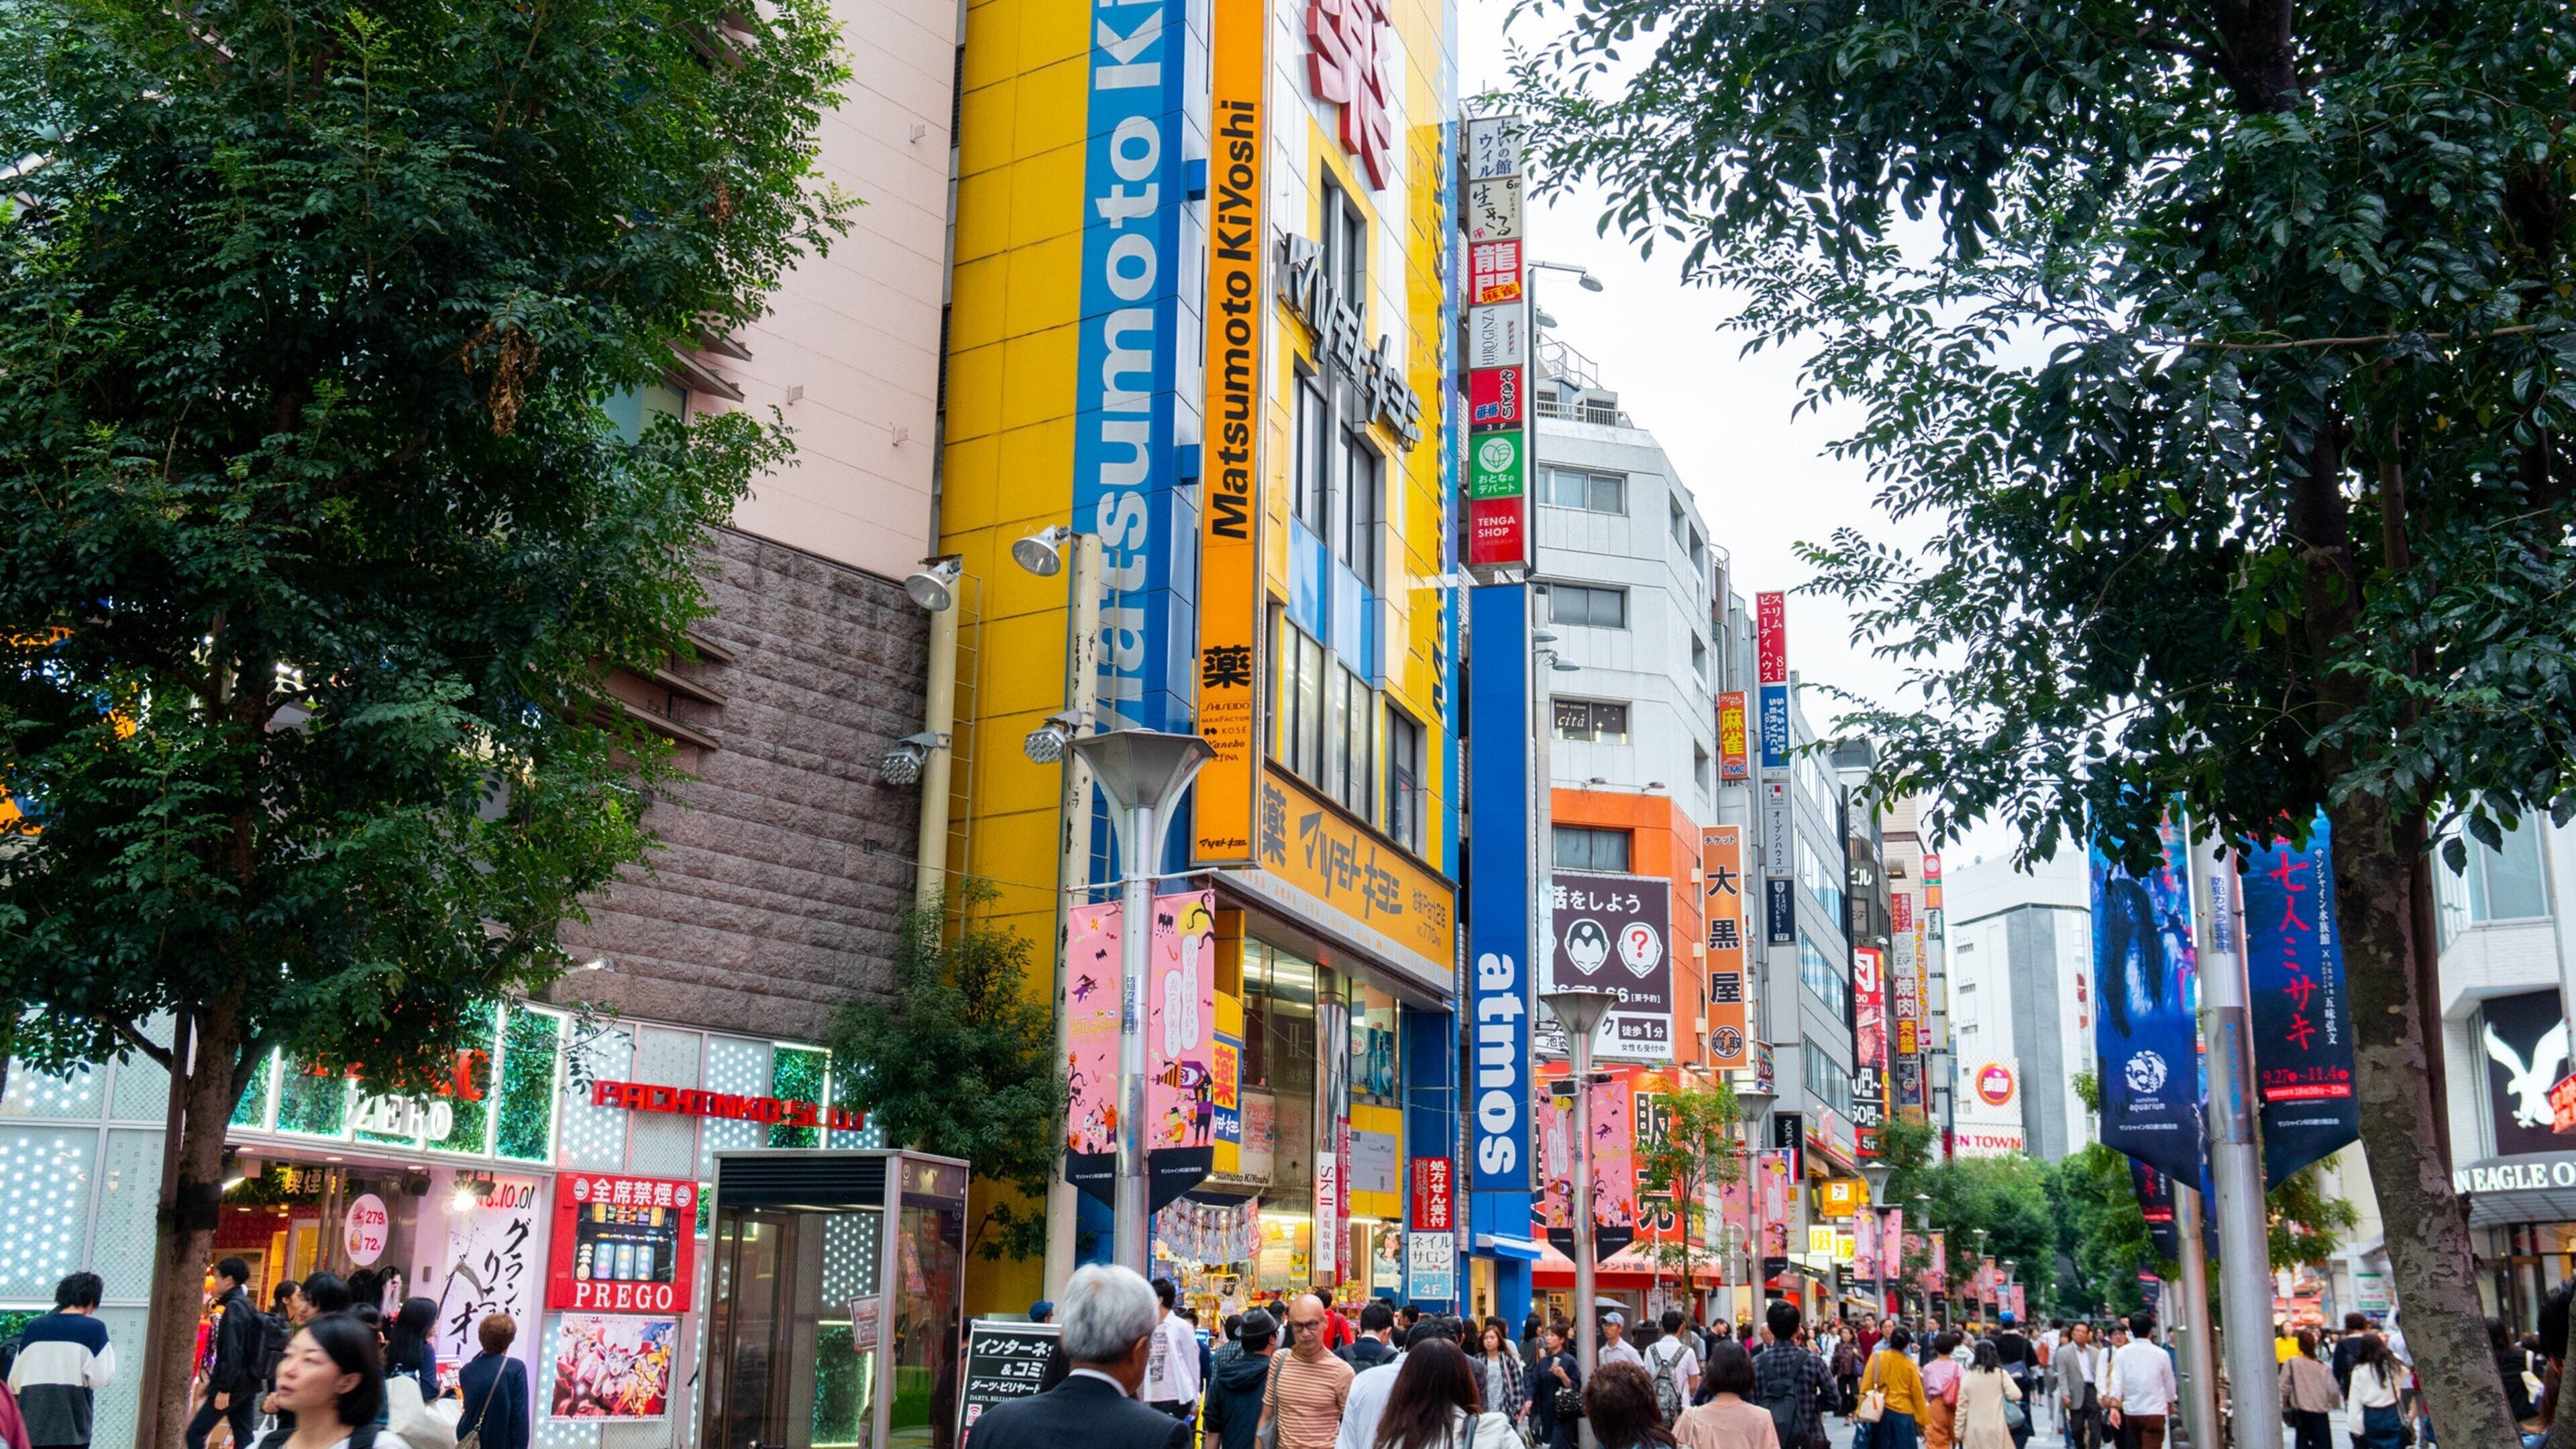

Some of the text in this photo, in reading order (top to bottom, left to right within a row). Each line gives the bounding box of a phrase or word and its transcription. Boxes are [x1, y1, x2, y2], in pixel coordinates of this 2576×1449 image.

[1482, 282, 1519, 303] 麻雀
[1212, 101, 1255, 539] Matsumoto KiYoshi
[1501, 370, 1515, 419] やきとり
[1479, 474, 1515, 484] おとなの
[1479, 484, 1515, 494] デパート
[1478, 515, 1516, 526] TENGA
[1478, 527, 1509, 537] SHOP
[1772, 594, 1783, 629] スリム
[1202, 645, 1252, 689] 薬
[1201, 702, 1250, 712] SHISEIDO
[1722, 708, 1745, 755] 麻雀
[1769, 698, 1777, 755] SERVICE
[1777, 698, 1786, 755] SYSTEM
[1705, 837, 1736, 845] チケット
[1773, 810, 1782, 865] オープンハウス
[1707, 866, 1742, 1004] 大黒屋
[2268, 851, 2318, 1051] 七人ミサキ
[1895, 977, 1915, 1017] 焼肉
[1621, 1021, 1664, 1039] 徒歩1分
[1214, 1046, 1236, 1106] 薬
[1478, 952, 1525, 1175] atmos
[343, 1088, 453, 1141] ZERO
[591, 1080, 780, 1124] PACHINKO
[2129, 1104, 2165, 1112] aquarium
[1974, 1135, 2022, 1149] TOWN
[592, 1177, 674, 1207] 全席禁煙
[2472, 1163, 2549, 1193] EAGLE
[2552, 1161, 2576, 1187] O
[1430, 1160, 1447, 1228] 処方せん受付
[1412, 1235, 1453, 1249] ネイル
[1412, 1250, 1453, 1265] サロン
[573, 1282, 674, 1310] PREGO
[1419, 1283, 1442, 1295] 4F
[1000, 1361, 1045, 1378] &コミ
